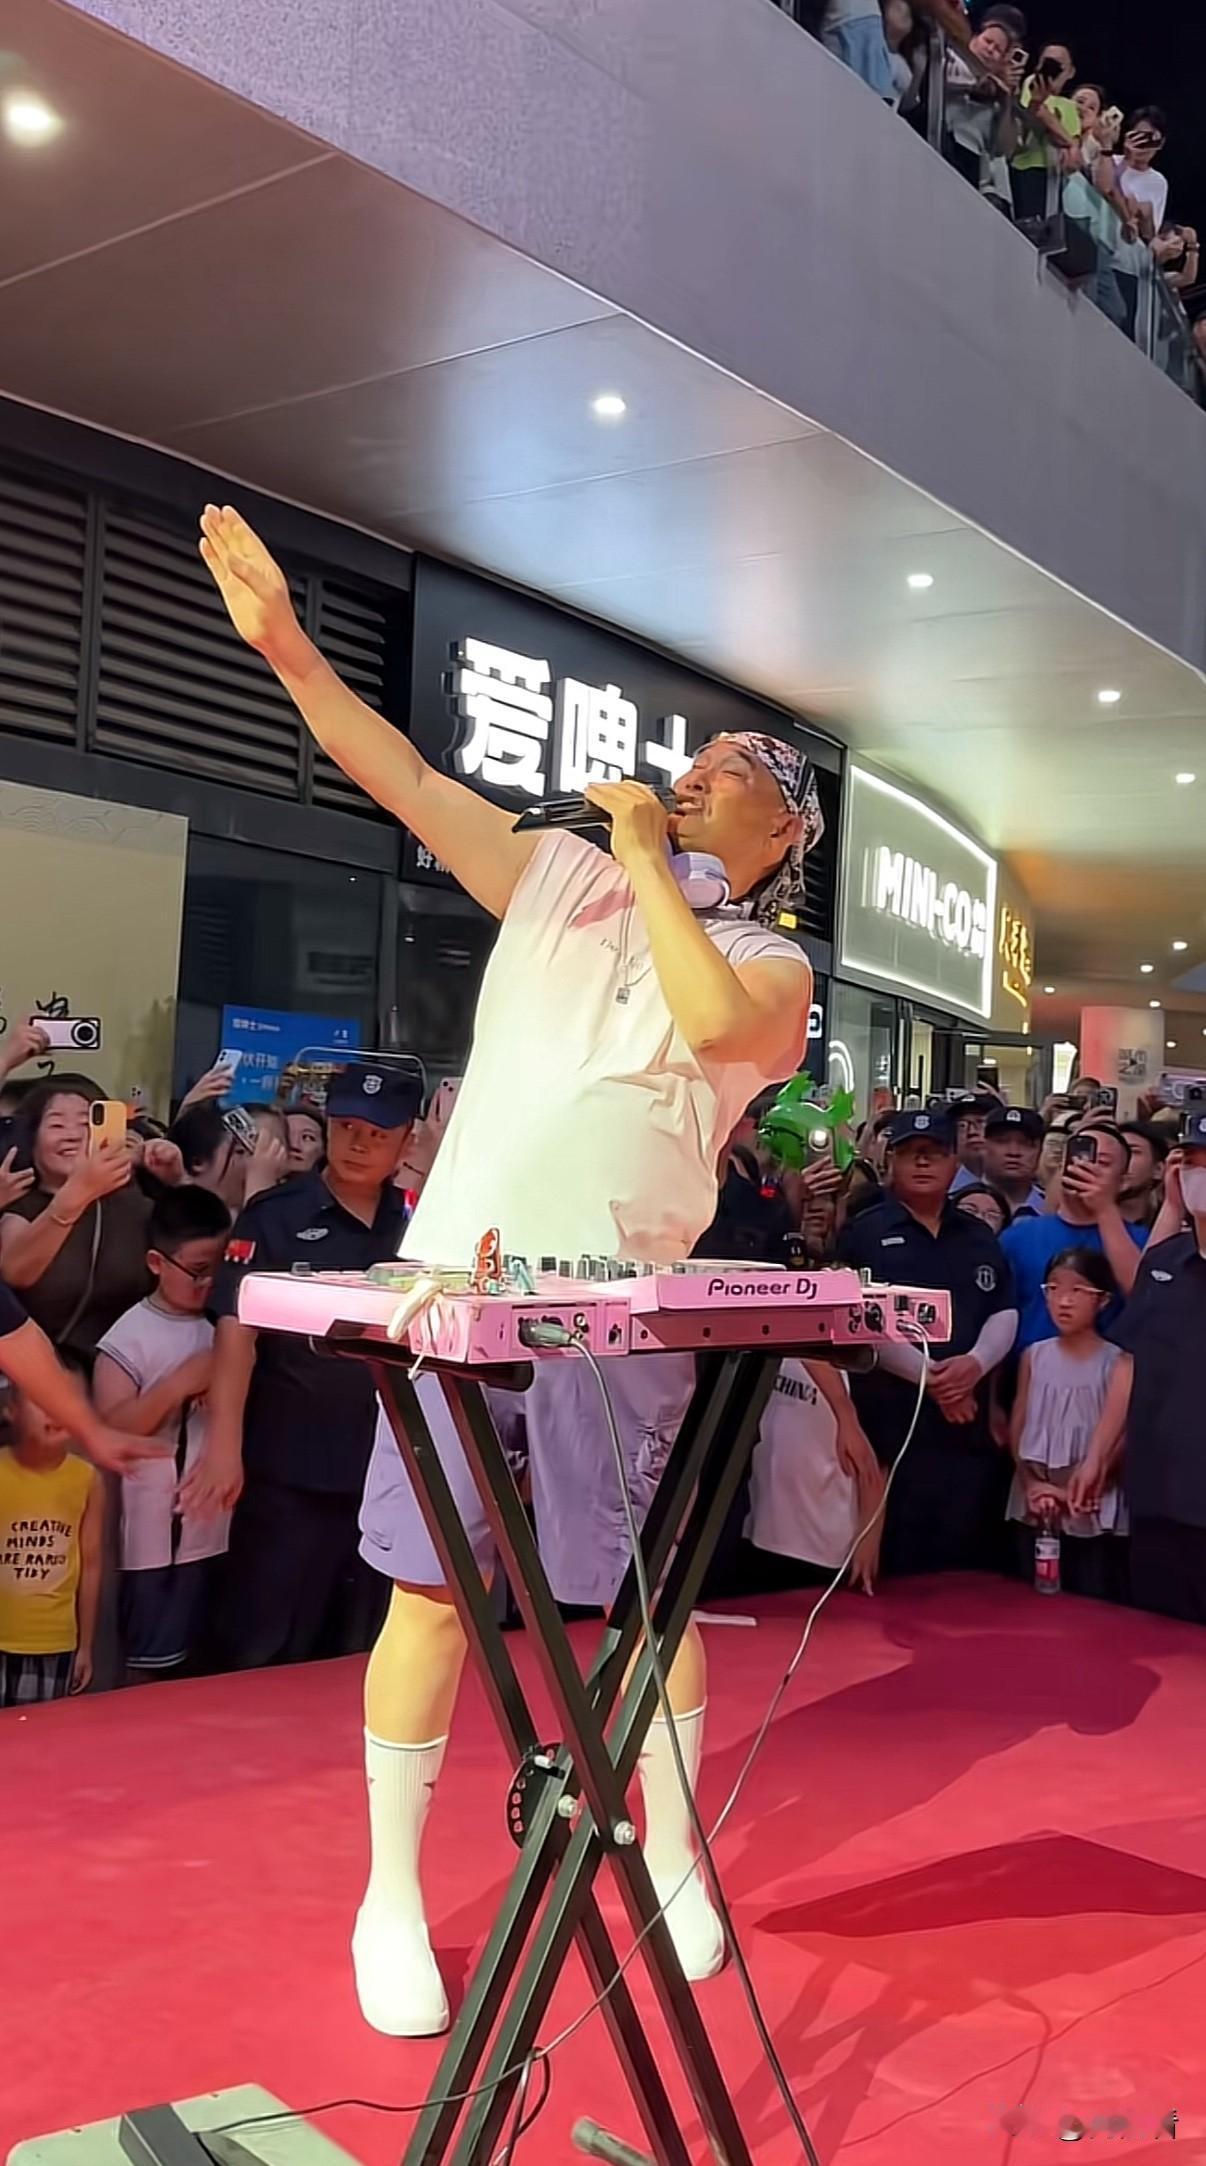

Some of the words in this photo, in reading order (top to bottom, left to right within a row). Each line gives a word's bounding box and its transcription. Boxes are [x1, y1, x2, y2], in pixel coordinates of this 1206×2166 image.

[707, 1278, 791, 1296] Pioneer
[6, 1536, 54, 1549] MINDS
[14, 1567, 50, 1580] TIDY
